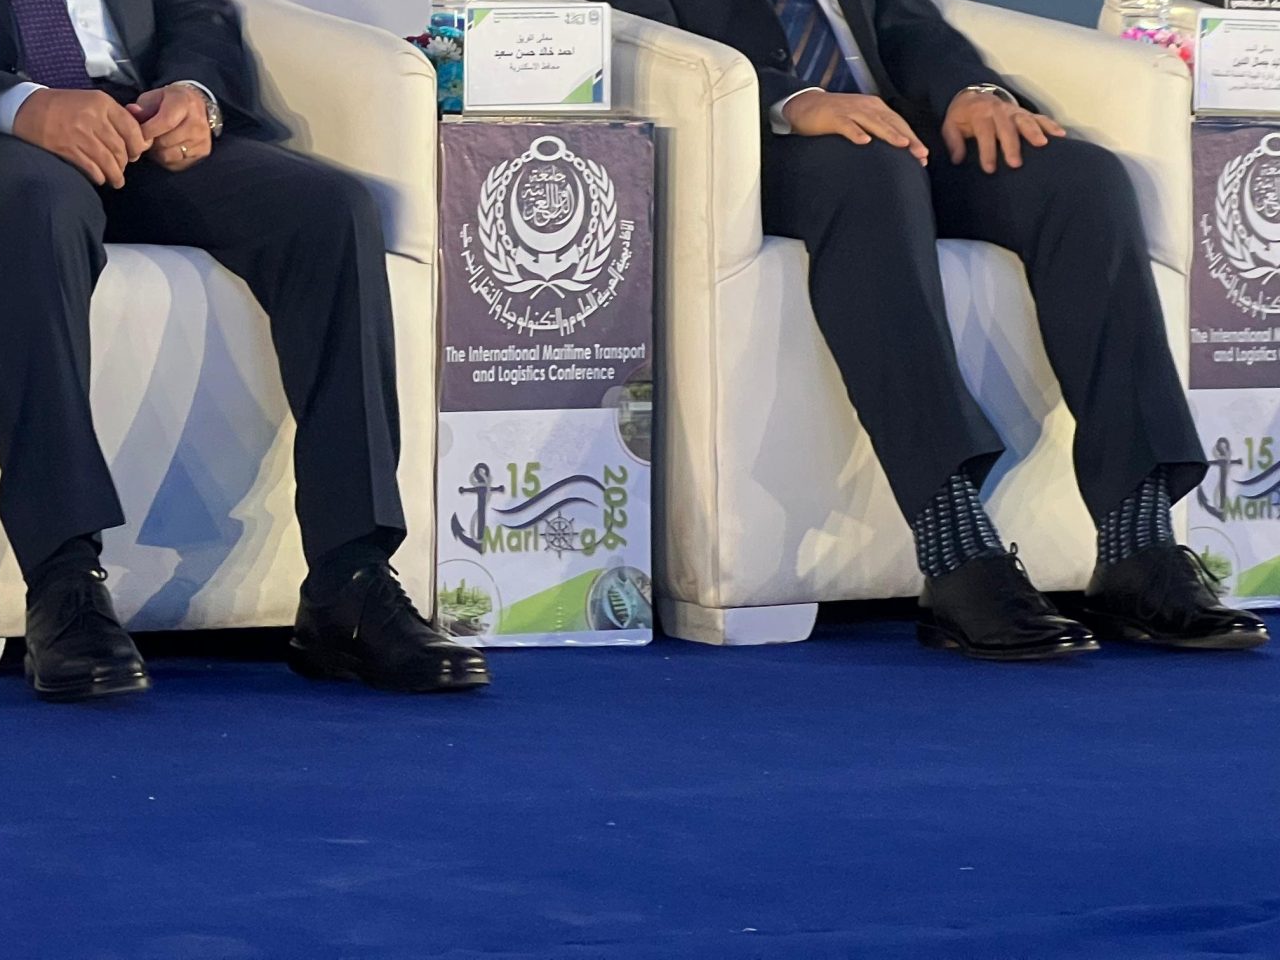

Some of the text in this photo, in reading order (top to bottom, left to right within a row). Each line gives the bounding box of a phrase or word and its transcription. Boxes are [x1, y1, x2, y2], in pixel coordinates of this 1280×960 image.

[1190, 328, 1208, 344] The
[1210, 327, 1273, 343] International
[445, 343, 646, 363] The International Maritime Transport
[1213, 346, 1277, 366] and Logistics
[472, 364, 616, 386] and Logistics Conference
[1244, 437, 1274, 471] 15
[506, 462, 542, 498] 15
[603, 464, 629, 554] 2026
